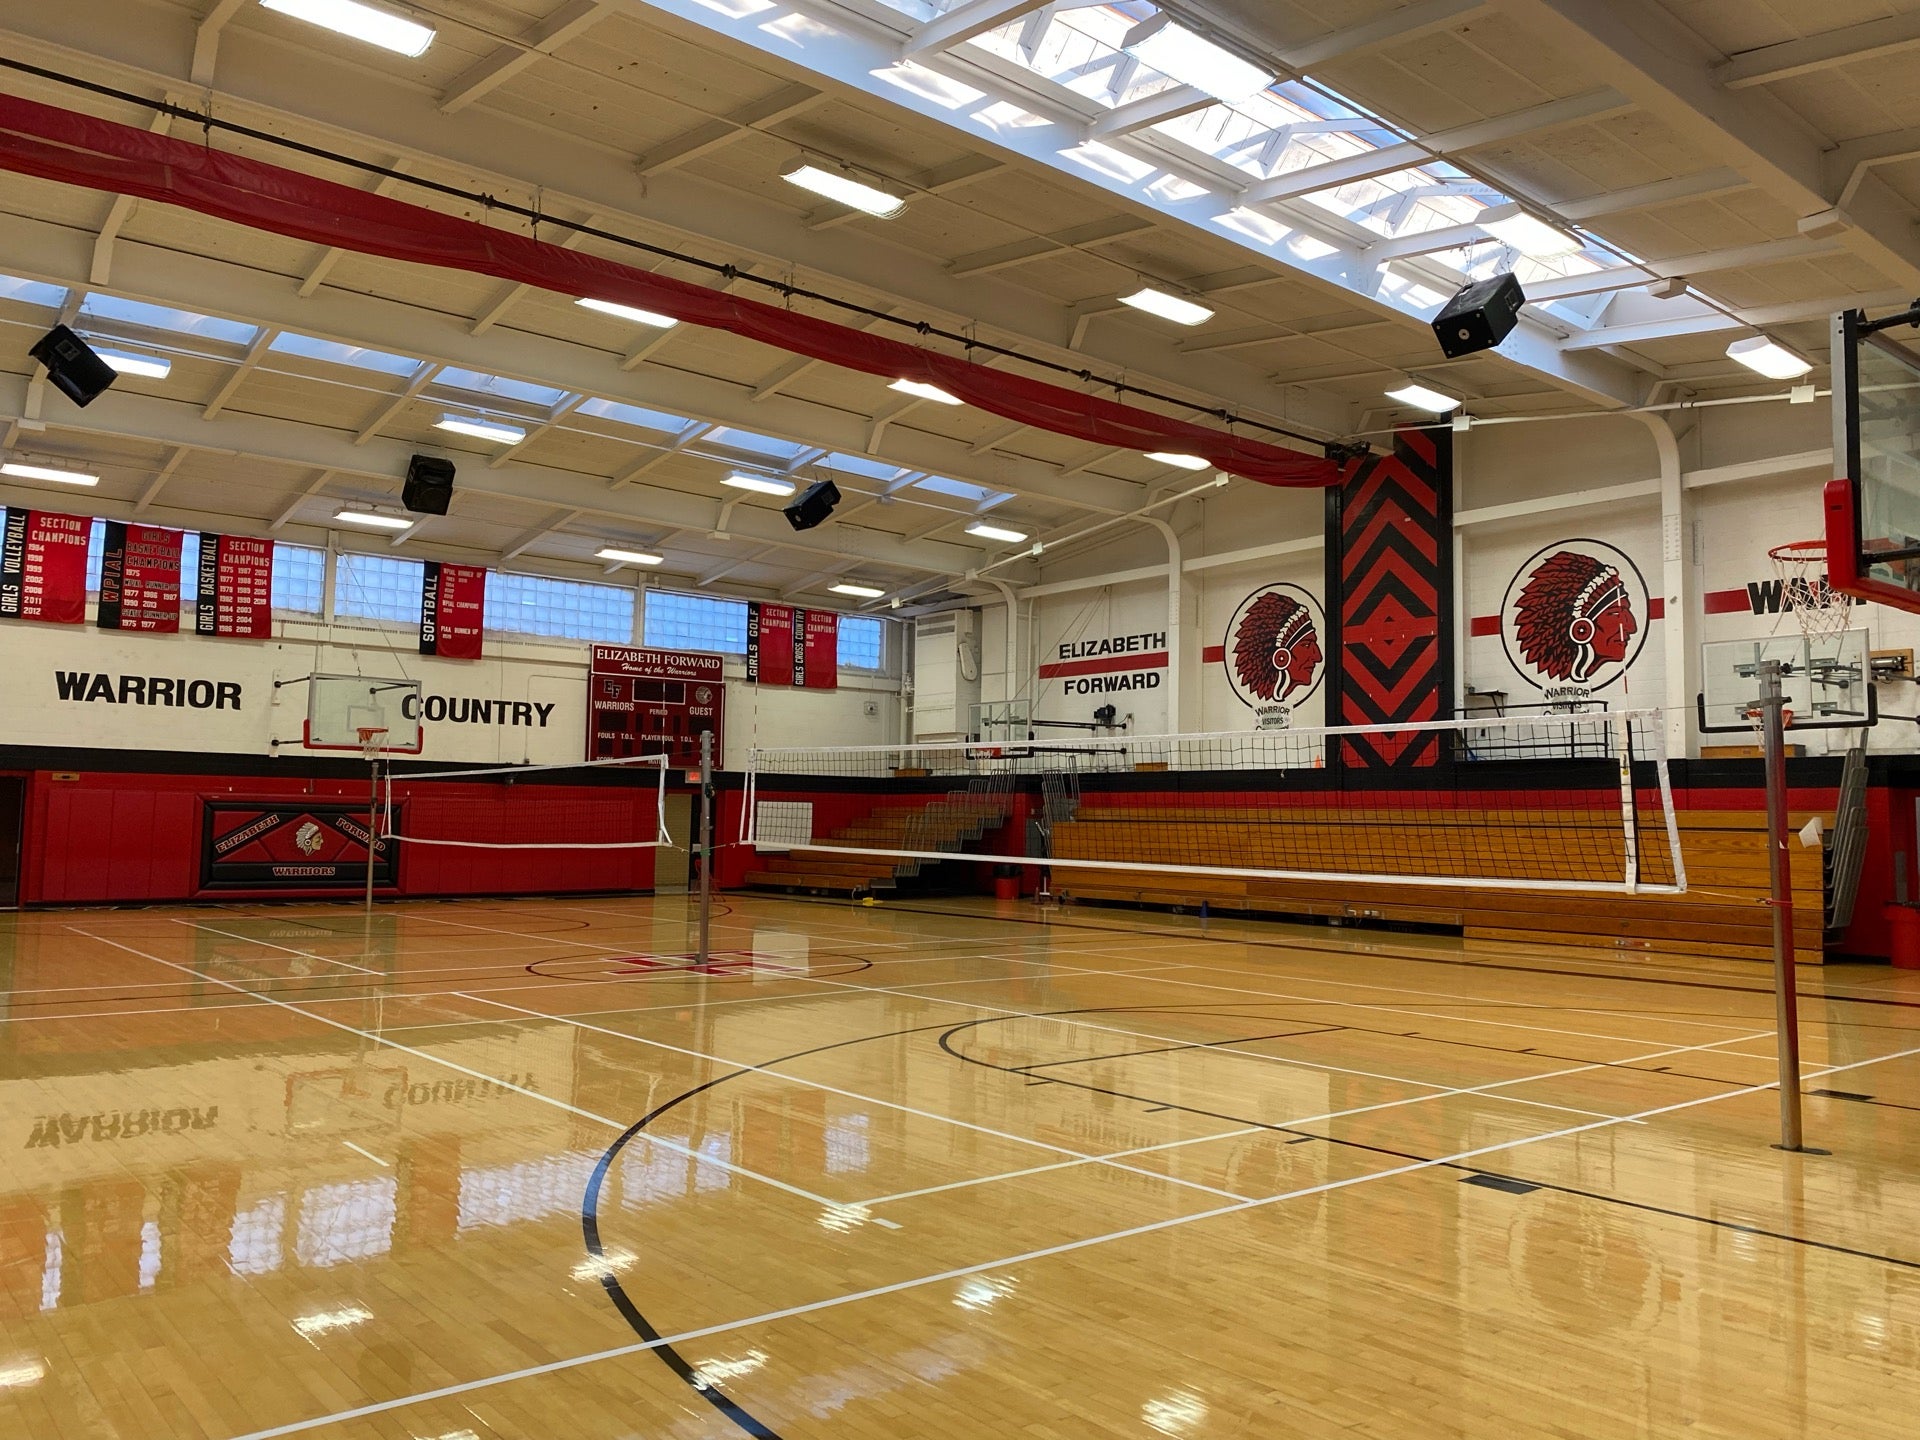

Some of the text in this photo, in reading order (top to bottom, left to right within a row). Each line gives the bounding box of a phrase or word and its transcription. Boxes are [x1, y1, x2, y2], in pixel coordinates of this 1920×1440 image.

[40, 517, 82, 531] SECTION
[32, 530, 87, 546] CHAMPIONS
[142, 531, 170, 543] GIRLS
[126, 541, 180, 558] BASKETBALL
[229, 541, 265, 554] SECTION
[1, 515, 26, 613] GIRLS VOLLEYBALL
[127, 556, 180, 571] CHAMPIONS
[223, 553, 270, 567] CHAMPIONS
[103, 548, 123, 602] WPIAL
[199, 538, 217, 631] GIRLS BASKETBALL
[124, 588, 139, 597] 1977
[23, 596, 42, 605] 2011
[23, 606, 41, 616] 2012
[422, 575, 438, 642] SOFTBALL
[766, 608, 789, 619] SECTION
[121, 618, 156, 629] 1975 1977
[762, 618, 791, 629] CHAMPIONS
[811, 613, 833, 624] SECTION
[807, 623, 836, 634] CHAMPIONS
[748, 608, 759, 677] GIRLS GOLF
[794, 609, 805, 685] GIRLS CROSS COUNTRY
[1059, 632, 1167, 660] ELIZABETH
[596, 648, 720, 669] ELIZABETH FORWARD
[621, 662, 697, 676] Home of the Warriors
[1064, 672, 1160, 696] FORWARD
[55, 671, 556, 728] WARRIOR COUNTRY
[1544, 686, 1590, 700] WARRIOR
[594, 700, 635, 712] WARRIORS
[649, 708, 668, 716] PERIOD
[689, 706, 714, 717] GUEST
[1255, 705, 1291, 717] WARRIOR
[1262, 717, 1284, 725] VISITORS
[597, 732, 616, 740] FOULS
[641, 734, 661, 742] PLAYER
[216, 814, 280, 853] ELIZABETH
[272, 866, 336, 876] WARRIORS
